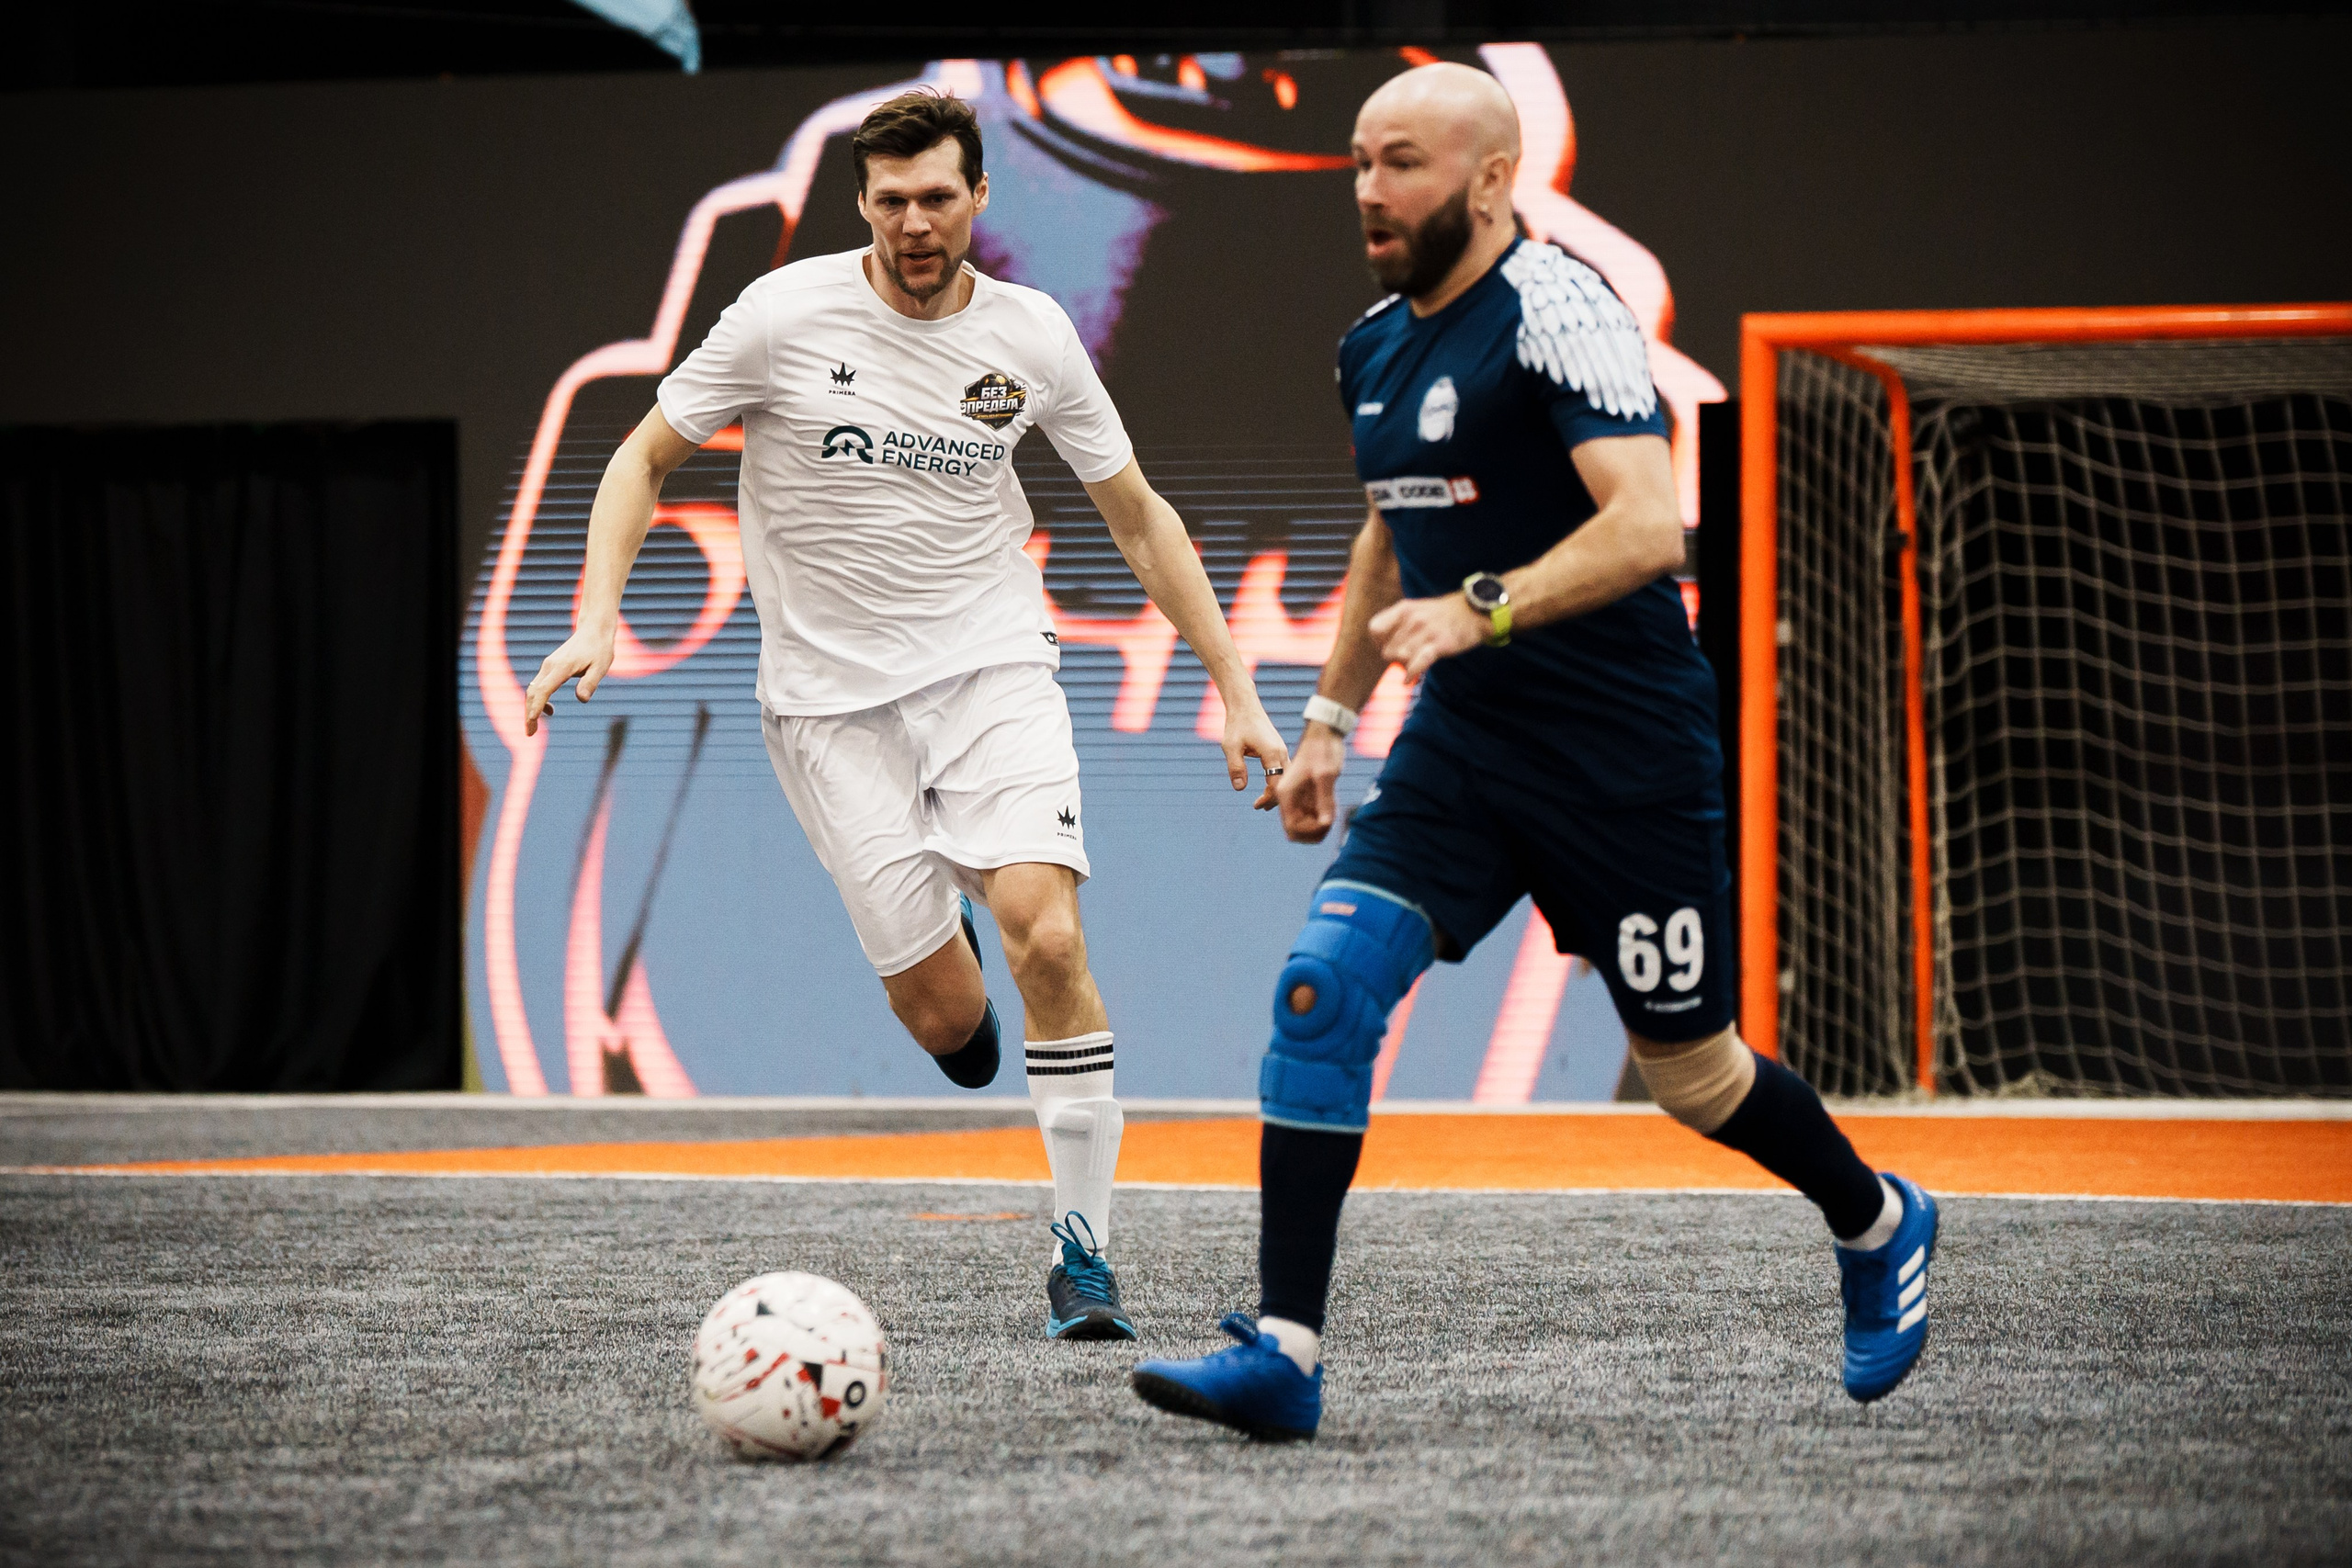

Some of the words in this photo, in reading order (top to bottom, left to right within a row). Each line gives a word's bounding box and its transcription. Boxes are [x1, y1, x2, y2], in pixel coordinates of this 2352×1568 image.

[981, 386, 1007, 400] БЕЗ
[882, 431, 1005, 460] ADVANCED
[881, 450, 978, 476] ENERGY
[1618, 907, 1704, 992] 69
